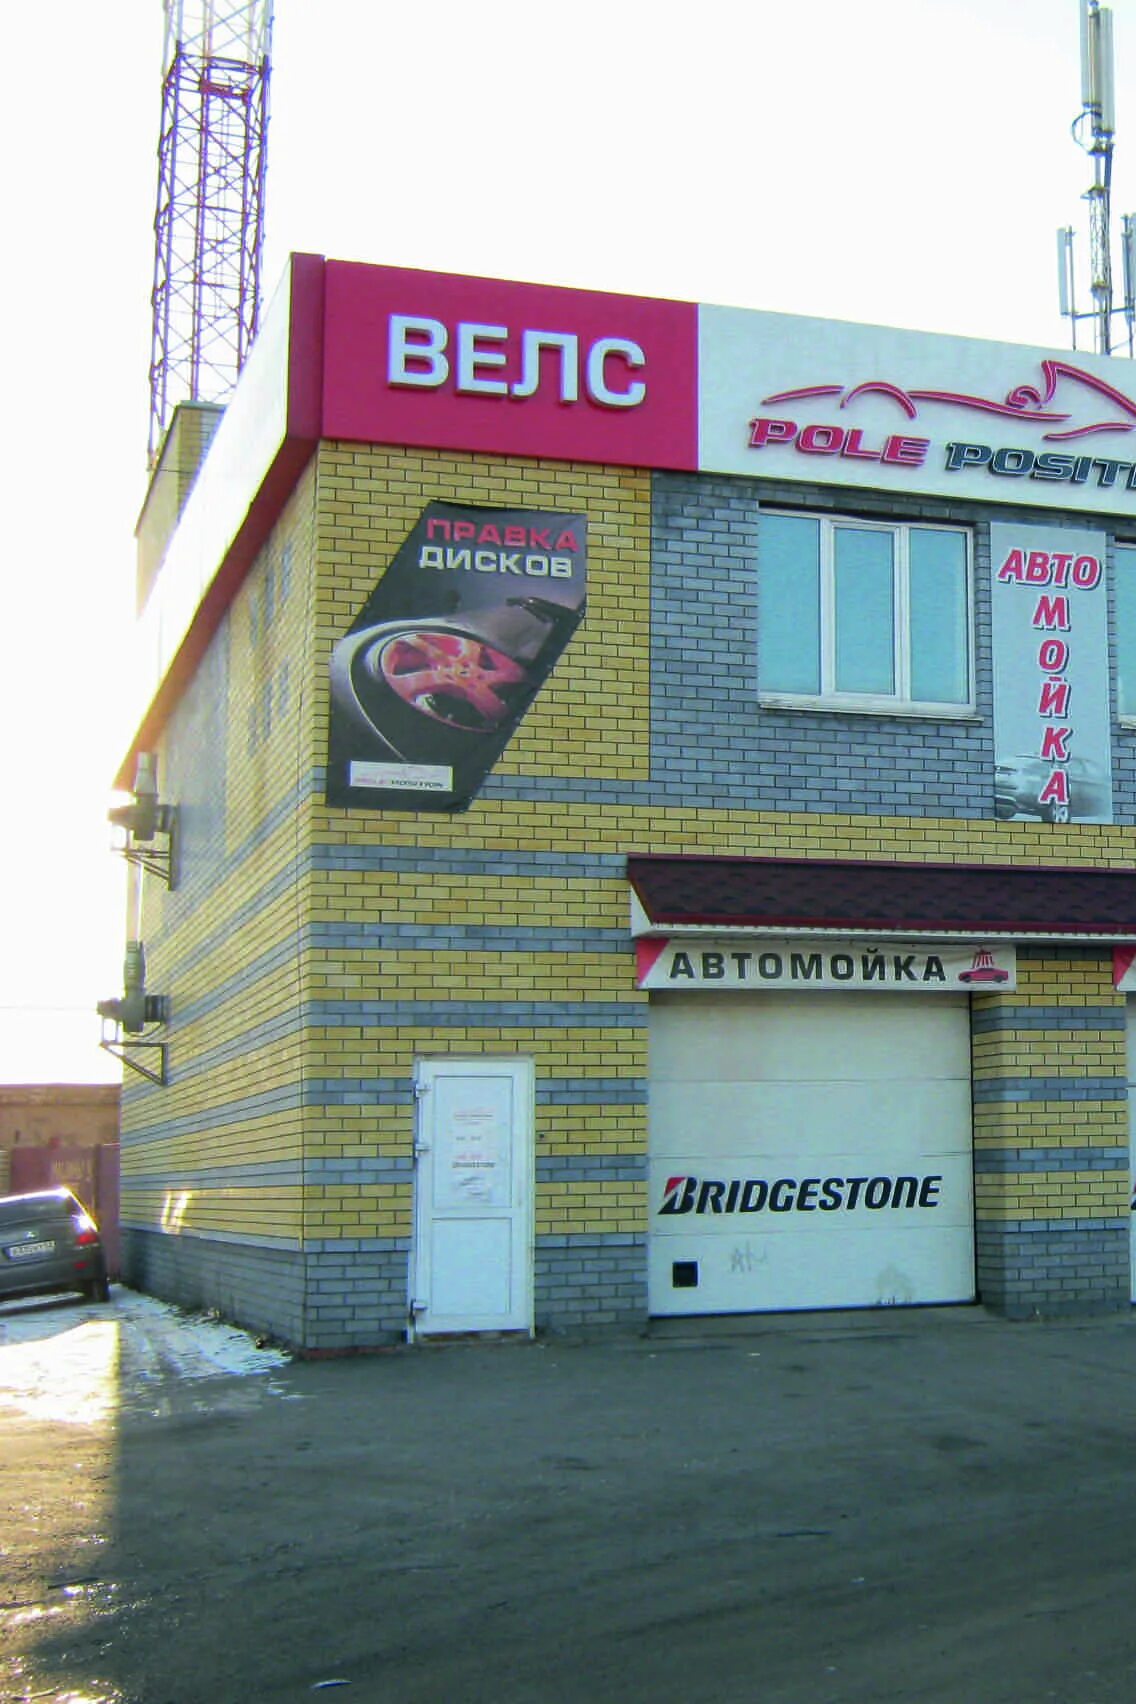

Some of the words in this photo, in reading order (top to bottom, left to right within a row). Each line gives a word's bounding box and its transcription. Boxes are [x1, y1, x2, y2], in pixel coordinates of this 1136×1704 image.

[387, 314, 647, 409] ВЕЛС
[748, 417, 930, 466] POLE
[425, 518, 579, 554] ПРАВКА
[418, 545, 573, 579] ДИСКОВ
[998, 548, 1101, 588] АВТО
[1032, 595, 1072, 806] МОЙКА
[668, 947, 948, 983] АВТОМОЙКА
[657, 1175, 943, 1216] BRIDGESTONE
